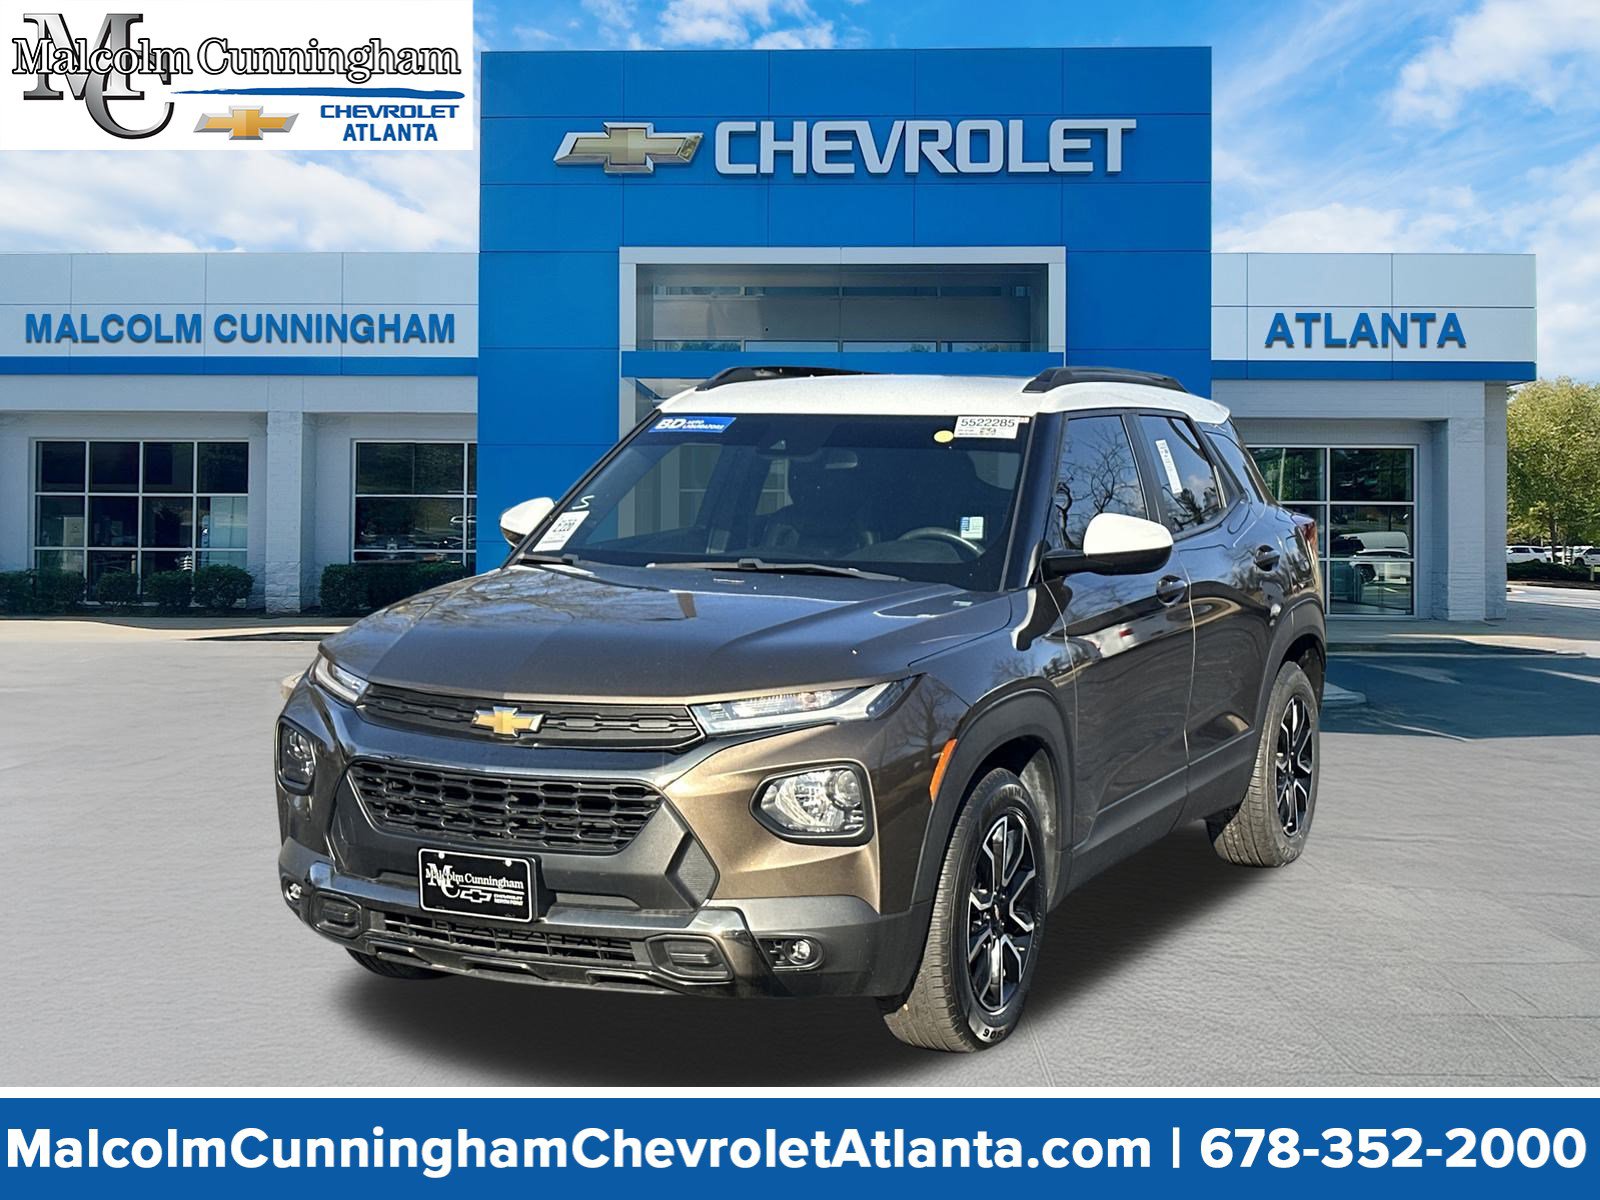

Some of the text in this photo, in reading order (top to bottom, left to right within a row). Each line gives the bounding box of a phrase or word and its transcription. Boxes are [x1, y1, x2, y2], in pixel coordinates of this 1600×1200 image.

[715, 119, 1137, 175] CHEVROLET
[25, 313, 455, 343] MALCOLM CUNNINGHAM
[1264, 313, 1467, 348] ATLANTA
[960, 418, 1016, 428] 5522285
[464, 873, 524, 889] Cunningham
